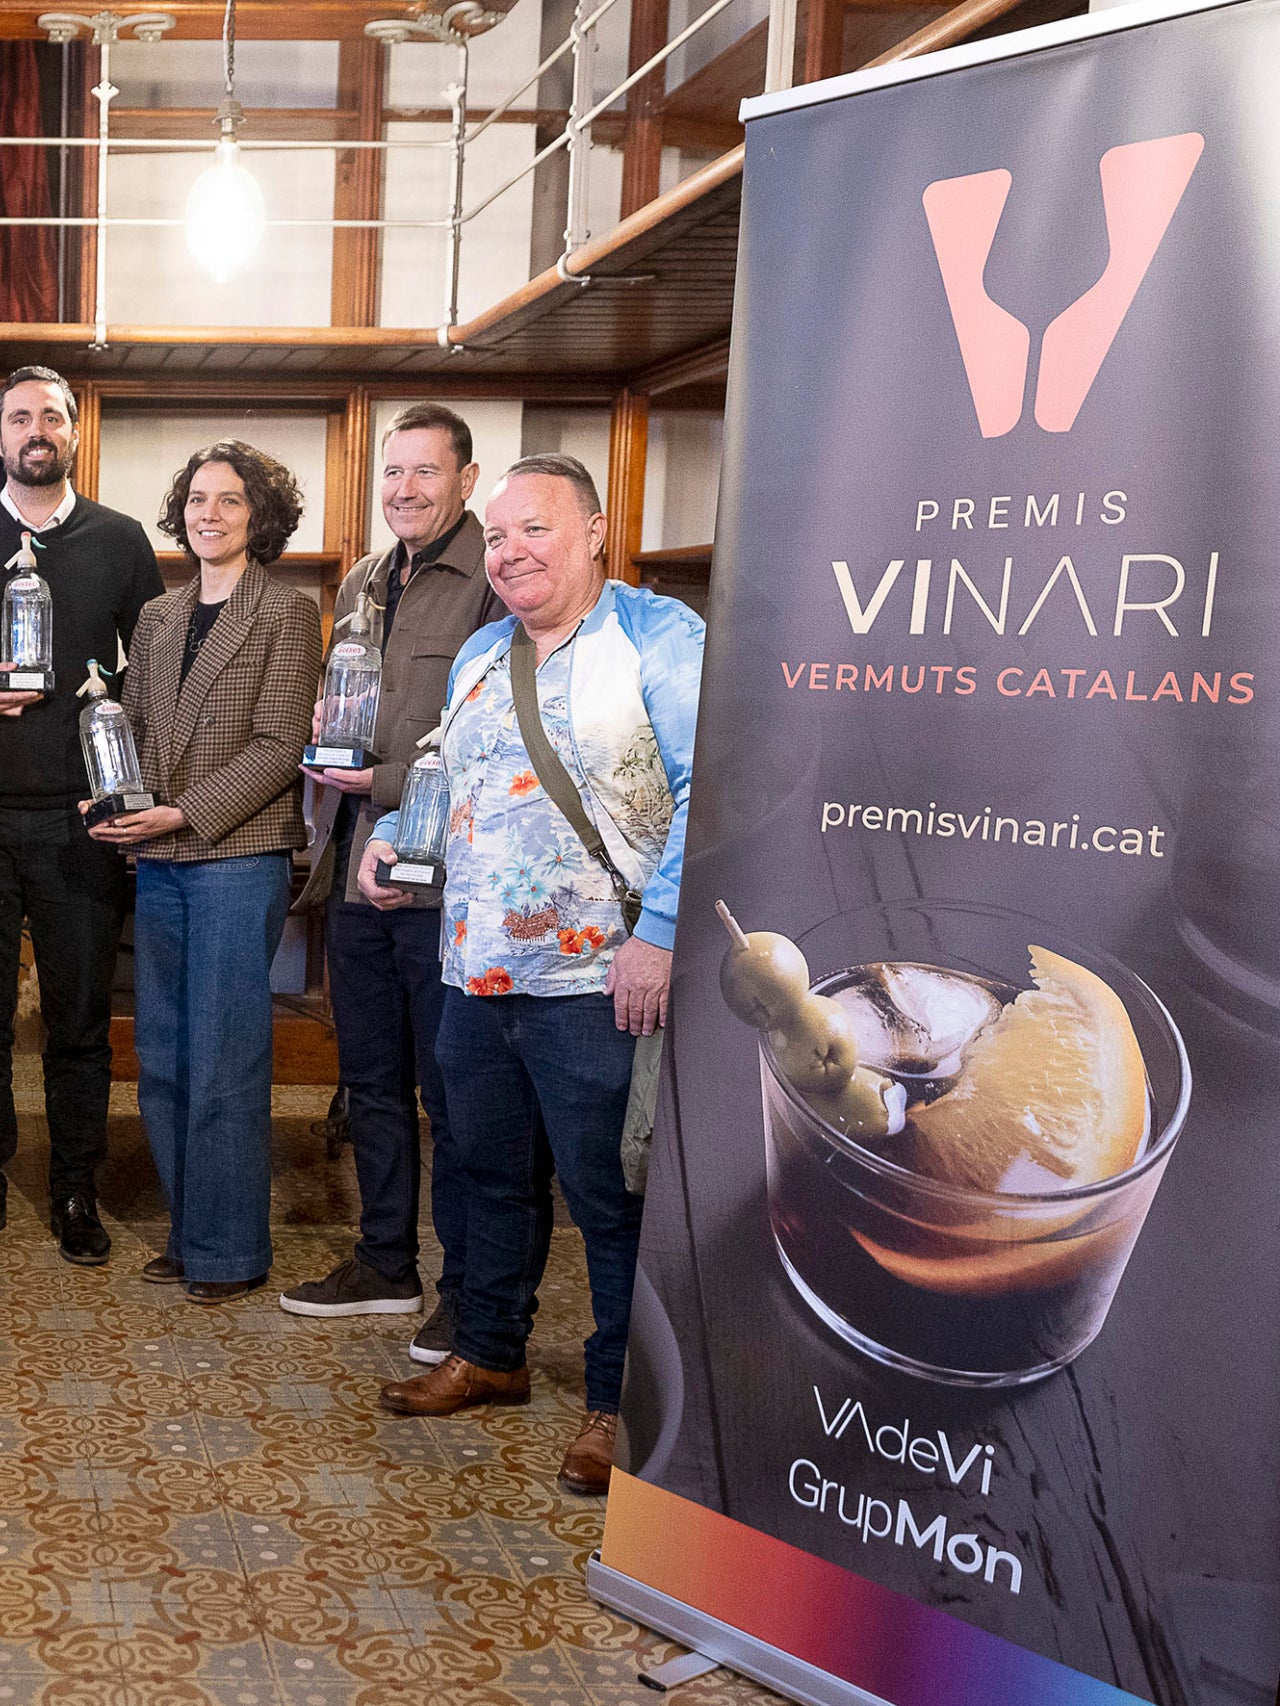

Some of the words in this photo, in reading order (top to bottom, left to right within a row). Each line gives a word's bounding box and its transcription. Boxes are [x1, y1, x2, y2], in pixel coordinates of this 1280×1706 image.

[915, 490, 1128, 532] PREMIS
[831, 551, 1219, 637] VINARI
[781, 662, 977, 695] VERMUTS
[997, 668, 1254, 704] CATALANS
[821, 802, 1165, 859] premisvinari.cat
[813, 1385, 995, 1496] VAdeVi
[788, 1458, 1023, 1595] GrupMón
